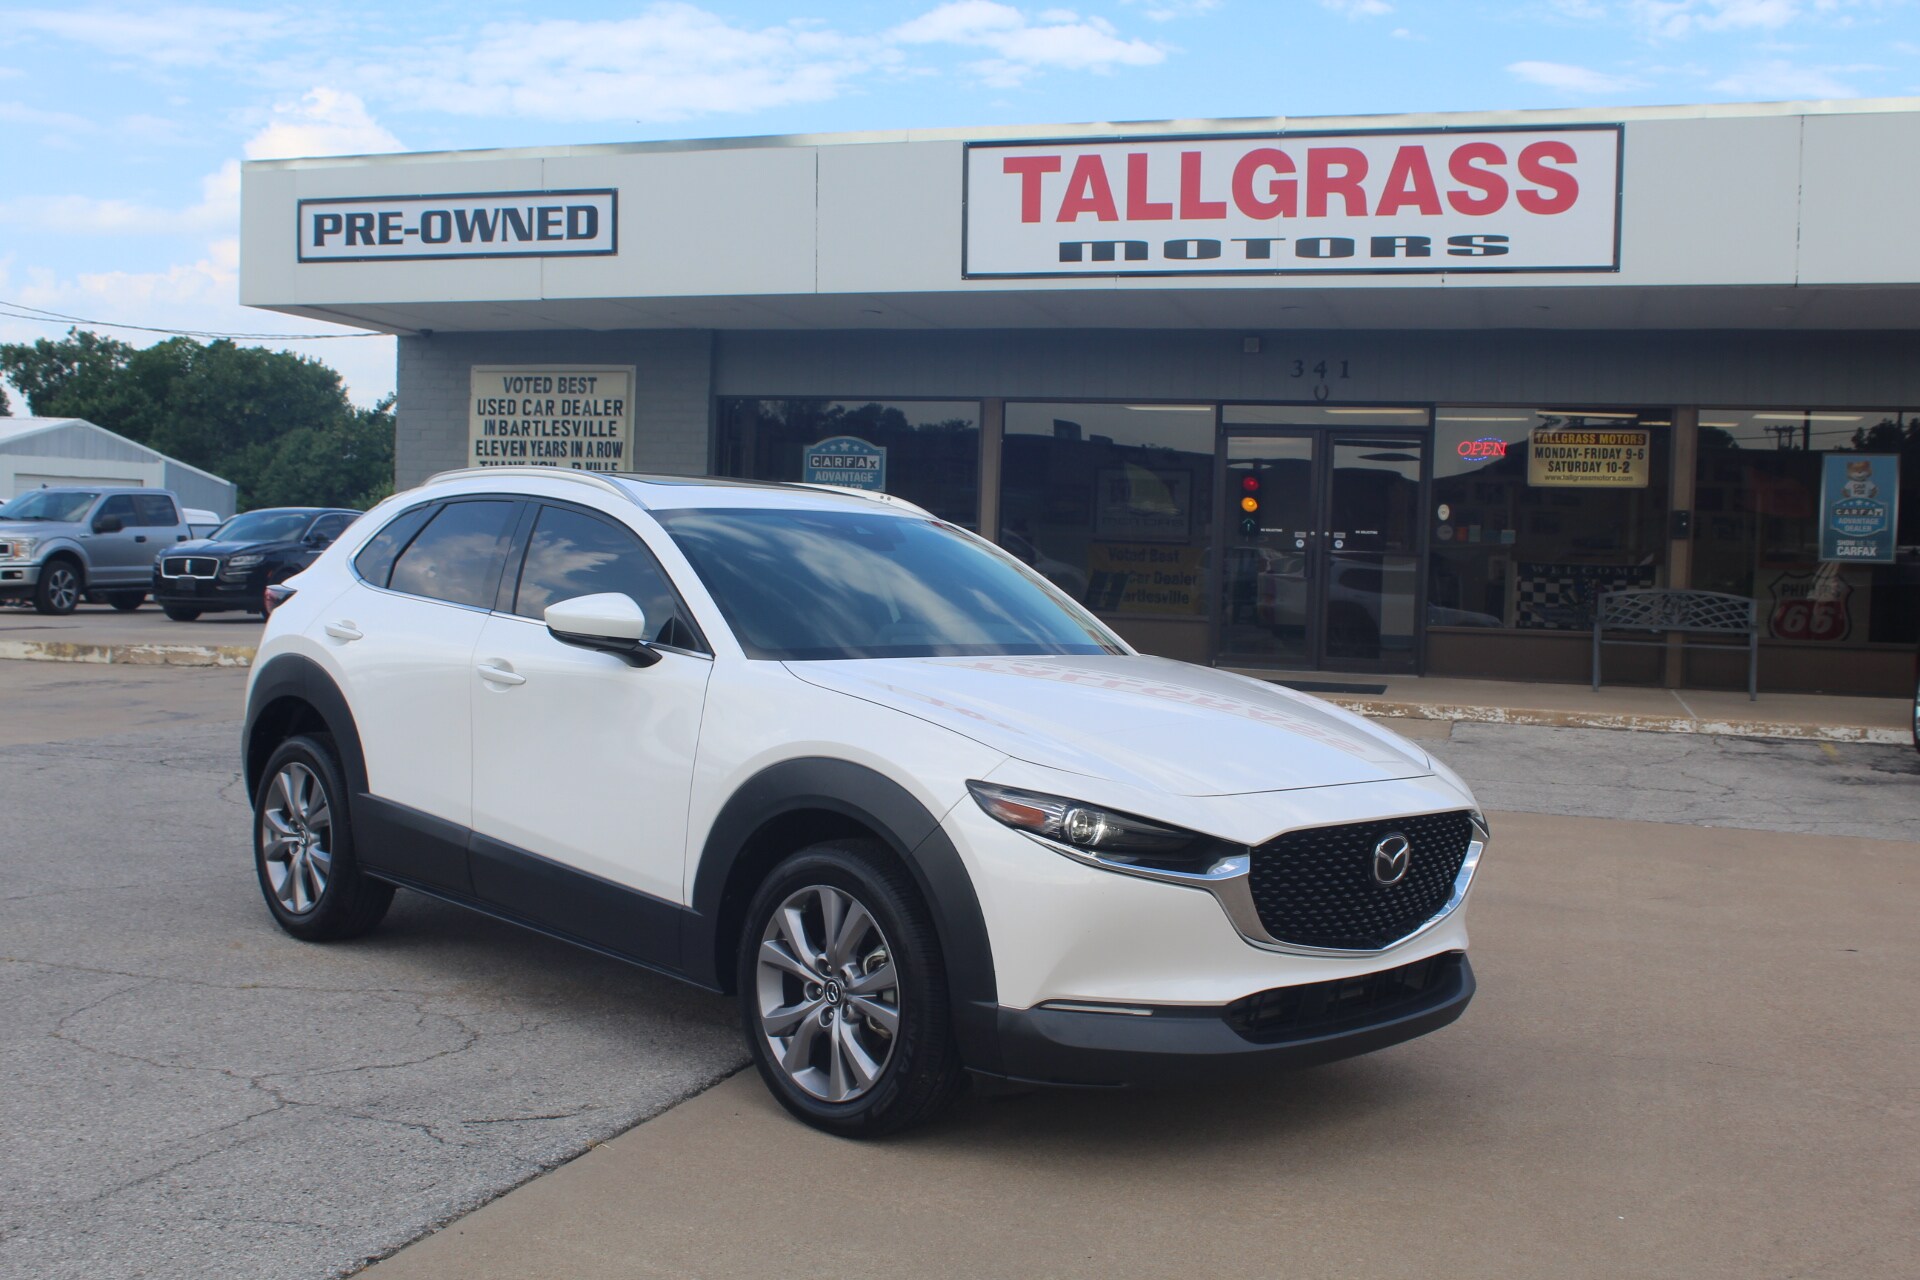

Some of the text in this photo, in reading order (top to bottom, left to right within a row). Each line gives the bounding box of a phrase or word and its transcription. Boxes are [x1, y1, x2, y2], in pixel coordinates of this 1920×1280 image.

[1002, 140, 1580, 223] TALLGRASS
[313, 205, 599, 247] PRE-OWNED
[1290, 359, 1350, 379] 341
[503, 376, 597, 394] VOTED BEST
[477, 399, 623, 417] USED CAR DEALER
[498, 419, 617, 437] BARTLESVILLE
[1535, 432, 1644, 445] TALLGRASS MOTORS
[475, 440, 623, 458] ELEVEN YEARS IN A ROW
[1457, 441, 1508, 456] OPEN
[1534, 447, 1644, 460] MONDAY-FRIDAY 9-6
[811, 455, 879, 470] CARFAX
[1547, 460, 1630, 473] SATURDAY 10-2
[815, 471, 874, 483] ADVANTAGE
[1544, 473, 1634, 482] www.tallgrassmotors.com
[1836, 547, 1877, 556] CARFAX
[1531, 563, 1643, 578] WELCOME
[1783, 604, 1835, 634] 66
